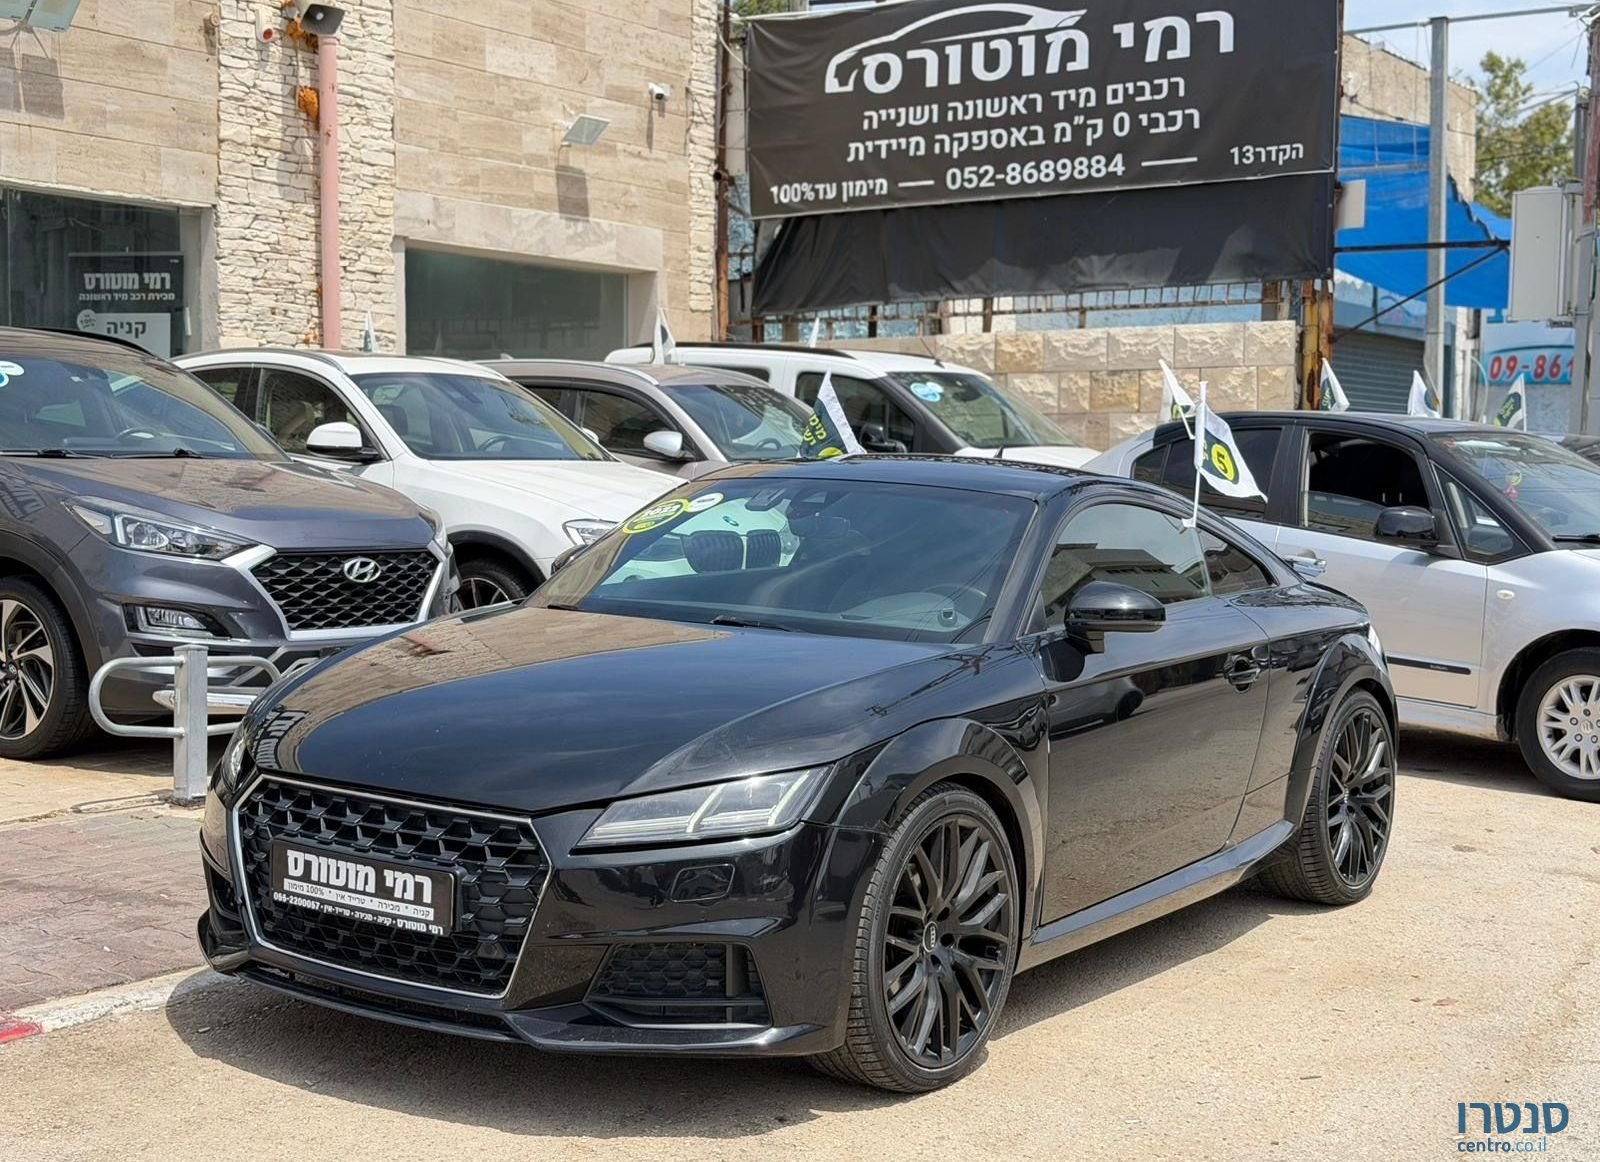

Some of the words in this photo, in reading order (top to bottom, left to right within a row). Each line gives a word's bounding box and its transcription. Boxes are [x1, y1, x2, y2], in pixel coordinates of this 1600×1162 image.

[1112, 10, 1234, 63] רמי
[861, 28, 1090, 94] מוטורס
[1050, 86, 1097, 111] מיד
[1106, 76, 1186, 105] רכבים
[862, 103, 939, 131] ושנייה
[947, 93, 1043, 122] ראשונה
[1112, 111, 1131, 138] 0
[1138, 108, 1201, 134] רכבי
[846, 135, 926, 163] מיידית
[934, 125, 1046, 159] באספקה
[946, 153, 1126, 190] 052-8689884
[841, 177, 888, 203] מימון
[83, 272, 140, 290] מוטורס
[143, 272, 171, 290] רמי
[106, 321, 147, 339] קניה
[286, 849, 376, 894] מוטורס
[383, 868, 432, 904] רמי
[354, 910, 373, 921] מכירה
[377, 901, 401, 912] מכירה
[412, 907, 431, 919] קניה
[377, 915, 392, 927] קניה
[396, 918, 427, 933] מוטורס
[428, 924, 444, 936] רמי
